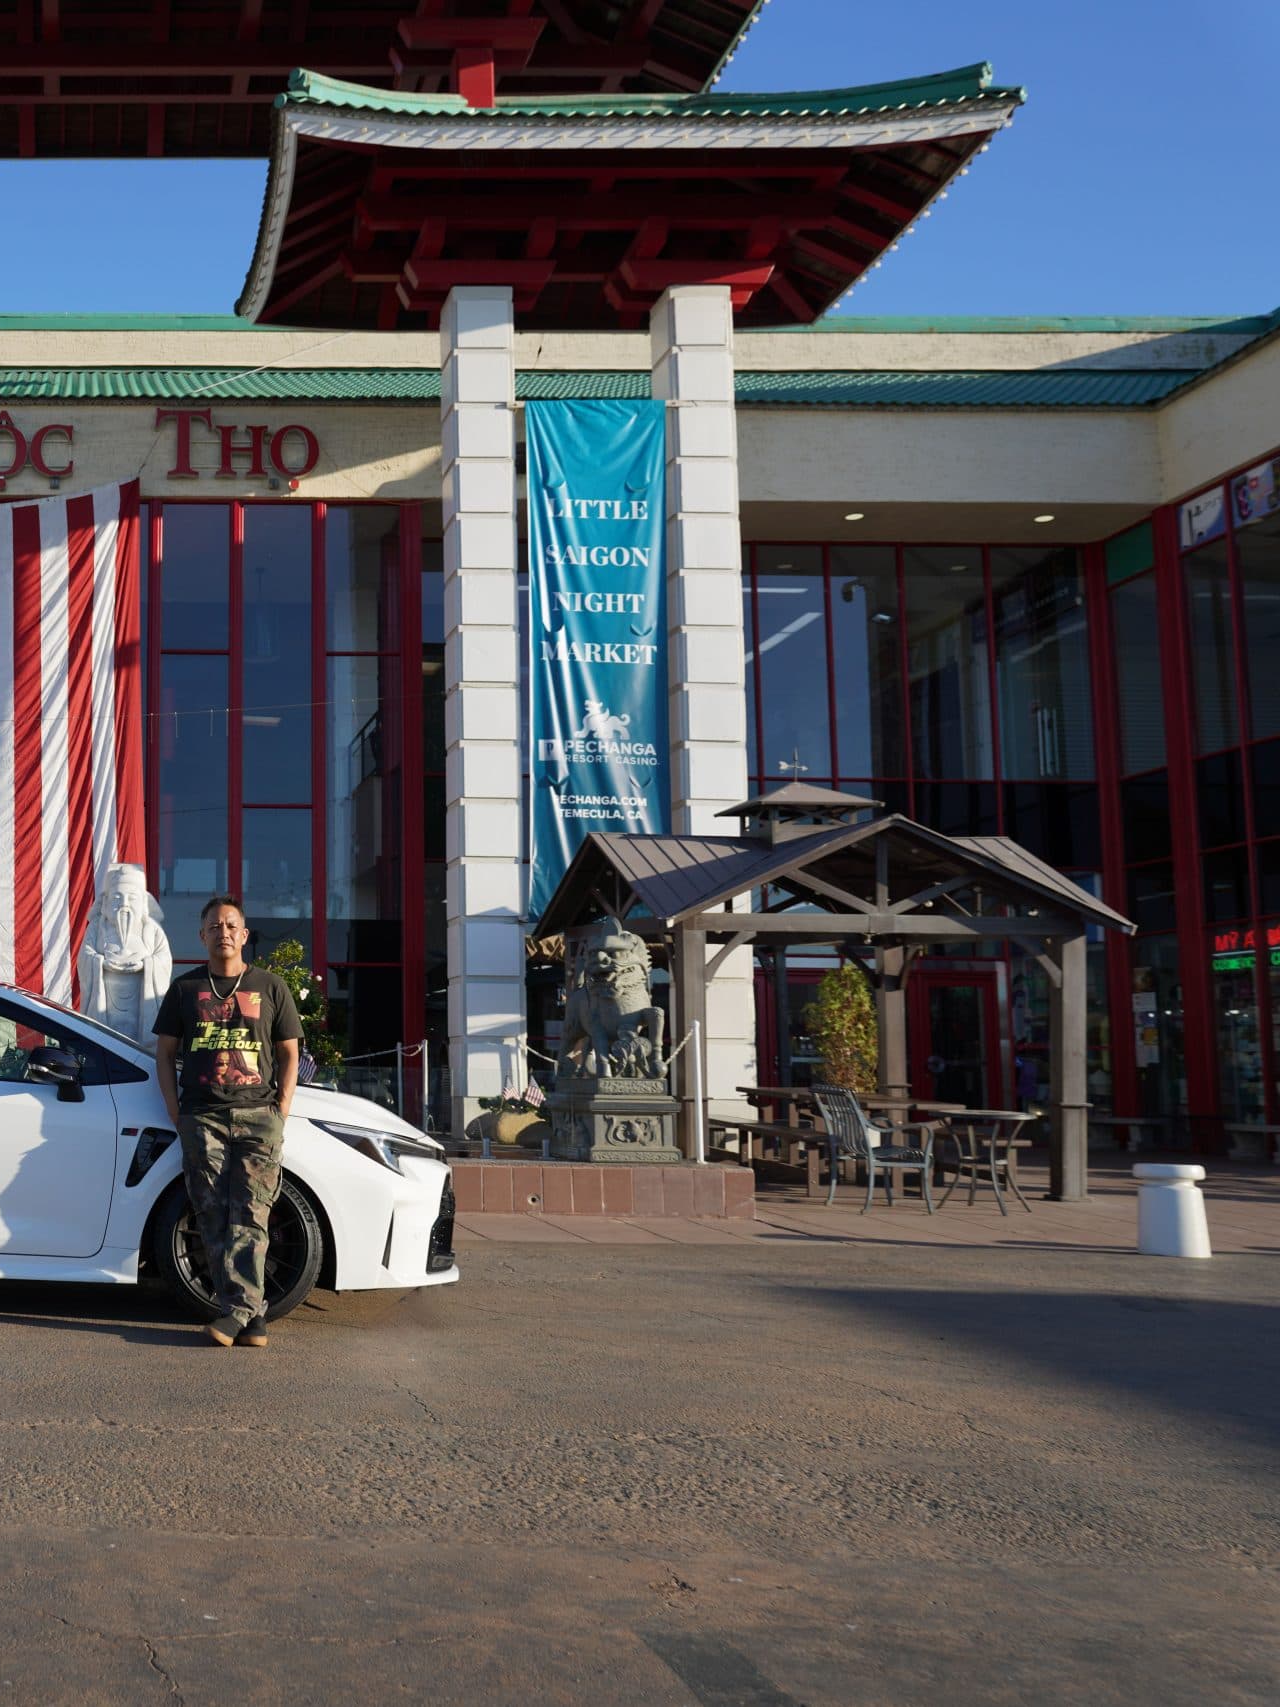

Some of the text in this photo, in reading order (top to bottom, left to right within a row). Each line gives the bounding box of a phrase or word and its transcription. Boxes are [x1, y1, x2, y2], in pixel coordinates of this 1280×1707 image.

[546, 498, 649, 520] LITTLE
[545, 544, 651, 567] SAIGON
[552, 591, 645, 614] NIGHT
[540, 640, 657, 665] MARKET
[564, 740, 657, 756] PECHANGA
[565, 754, 658, 766] RESORT CASINO
[559, 808, 646, 820] TEMECULA, CA
[204, 1025, 250, 1038] FAST
[191, 1037, 263, 1052] FURIOUS
